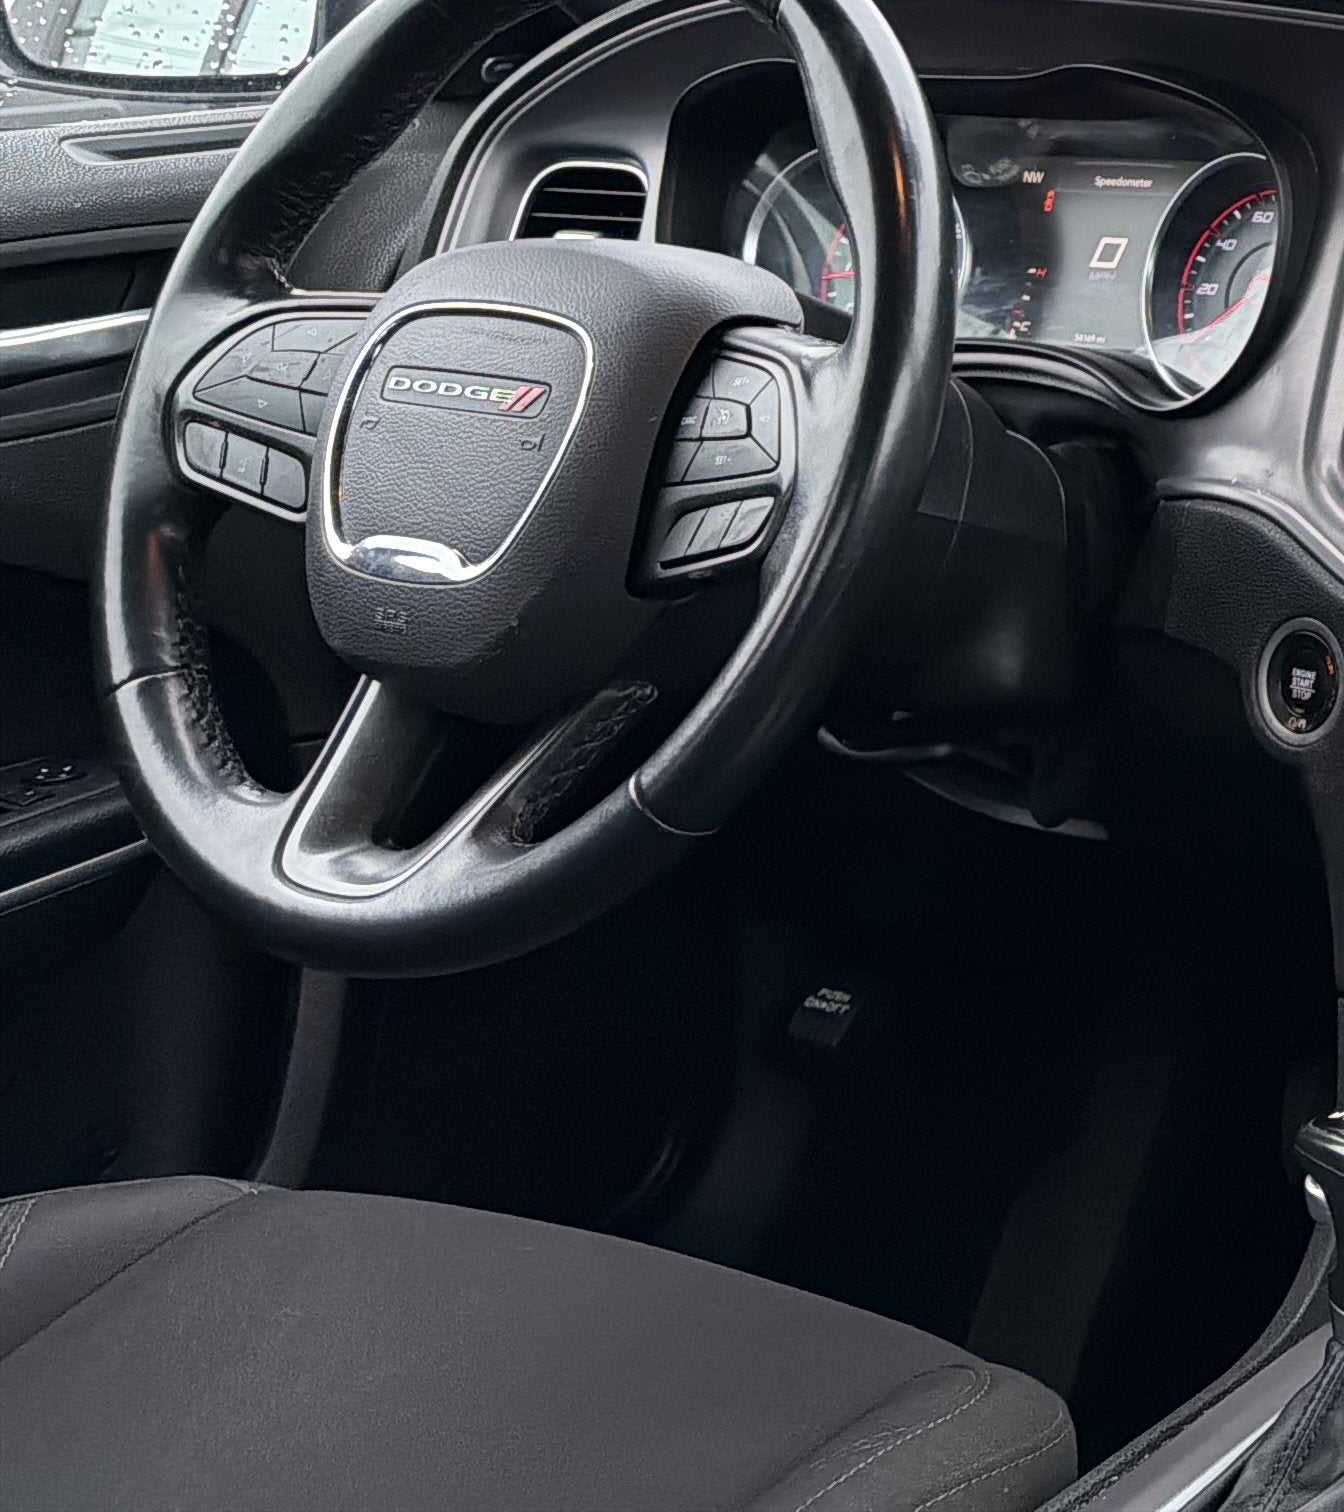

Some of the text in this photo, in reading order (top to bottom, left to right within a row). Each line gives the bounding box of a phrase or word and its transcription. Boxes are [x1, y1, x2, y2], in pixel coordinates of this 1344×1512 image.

[1022, 170, 1045, 185] NW
[1094, 175, 1153, 189] Speedometer
[1251, 211, 1275, 224] 60
[1215, 239, 1238, 251] 40
[1089, 236, 1129, 269] 0
[1036, 269, 1048, 278] H
[1196, 283, 1220, 296] 20
[388, 376, 516, 404] DODGE
[1292, 667, 1317, 679] ENGINE
[1291, 677, 1314, 689] START
[1292, 690, 1312, 701] STOP
